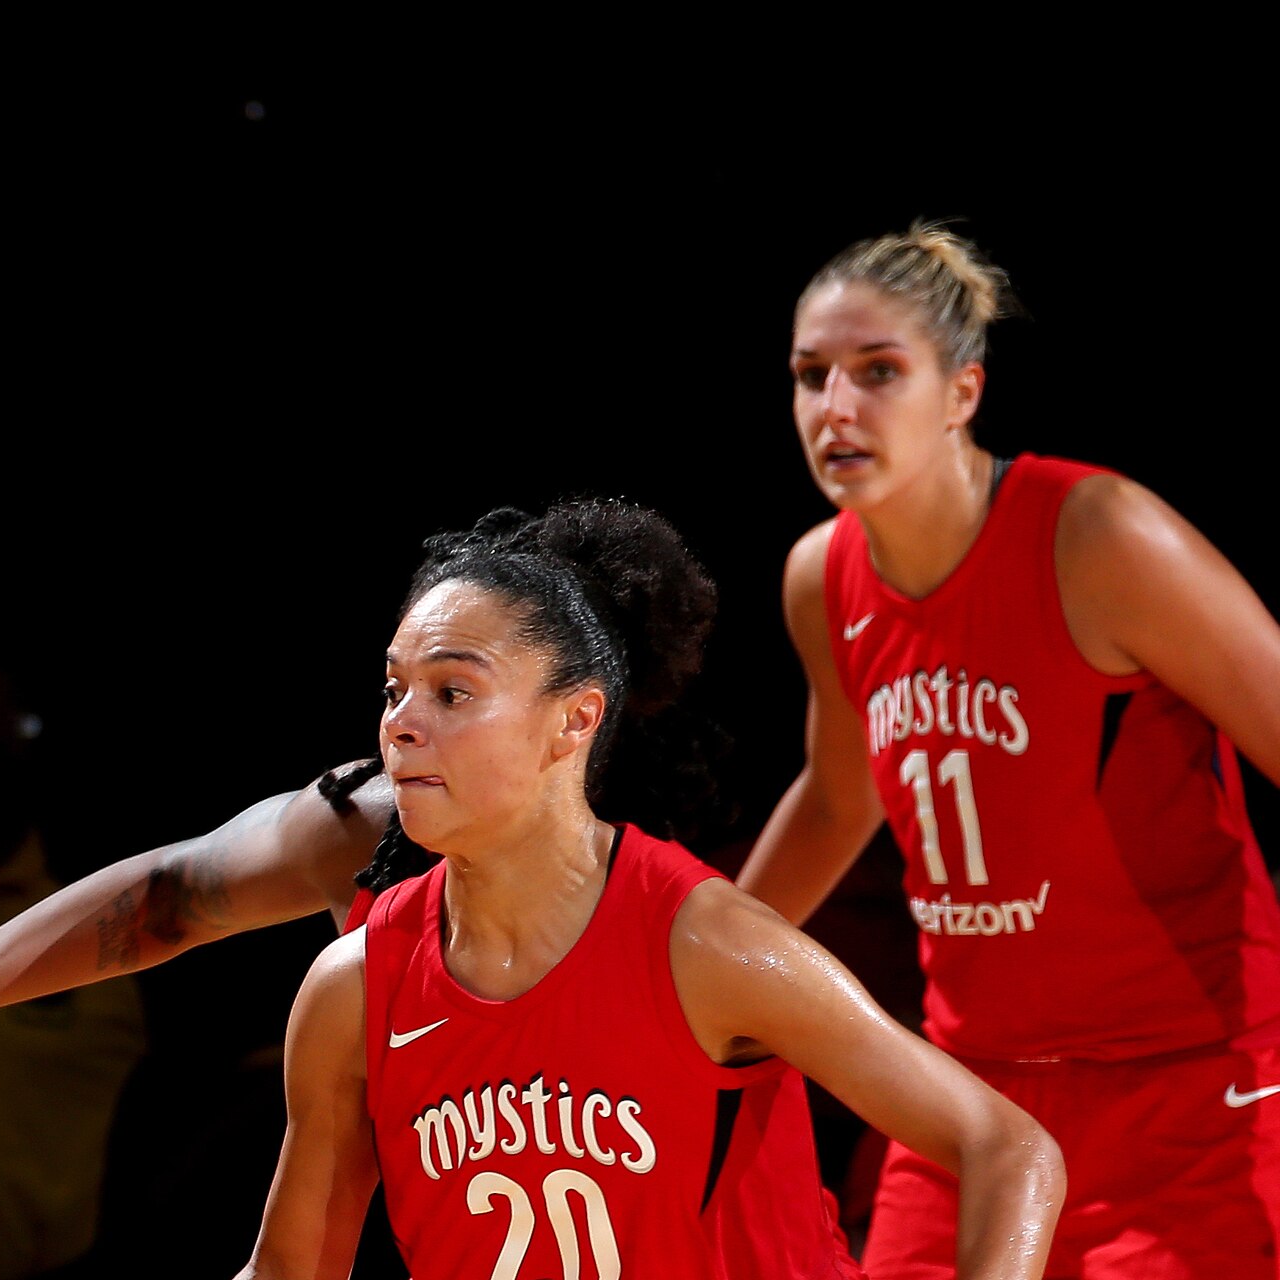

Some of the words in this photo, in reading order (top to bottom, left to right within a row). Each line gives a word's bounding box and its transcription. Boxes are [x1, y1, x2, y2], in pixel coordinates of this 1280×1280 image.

[867, 664, 1030, 757] mystics
[898, 749, 989, 886] 11
[411, 1070, 657, 1180] mystics
